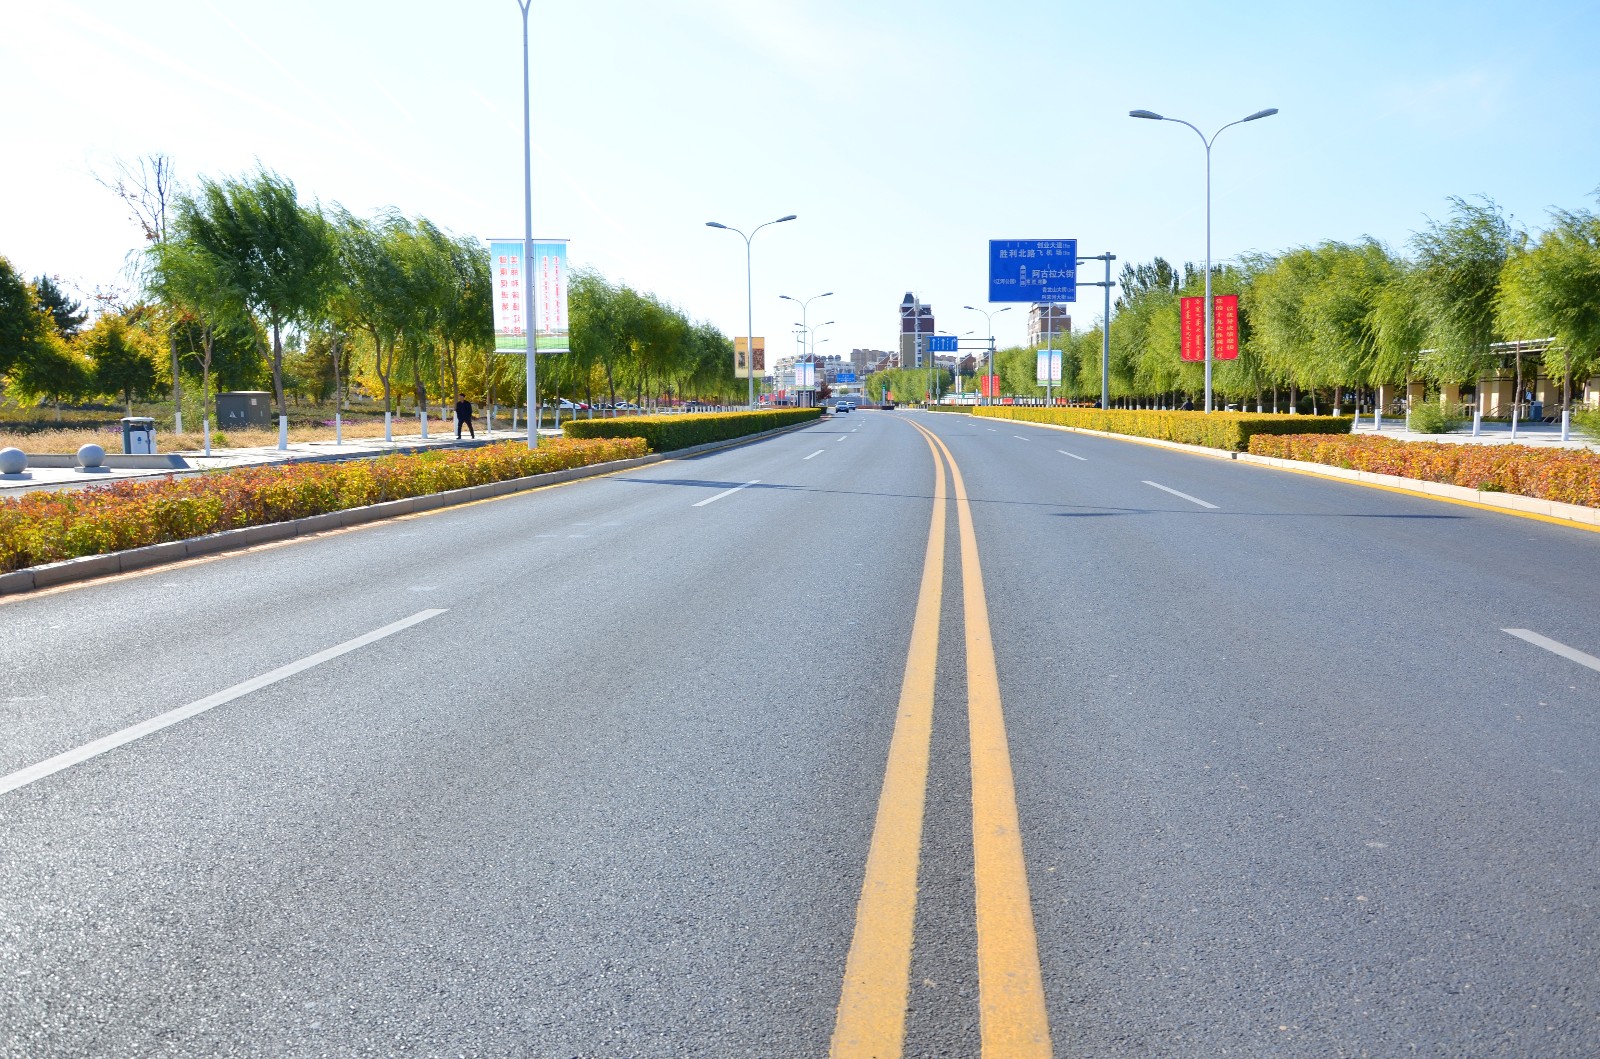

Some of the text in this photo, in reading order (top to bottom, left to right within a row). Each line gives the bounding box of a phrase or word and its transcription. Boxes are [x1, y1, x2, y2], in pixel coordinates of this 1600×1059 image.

[1000, 249, 1035, 258] 胜利北路
[1032, 269, 1075, 278] 阿古拉大街
